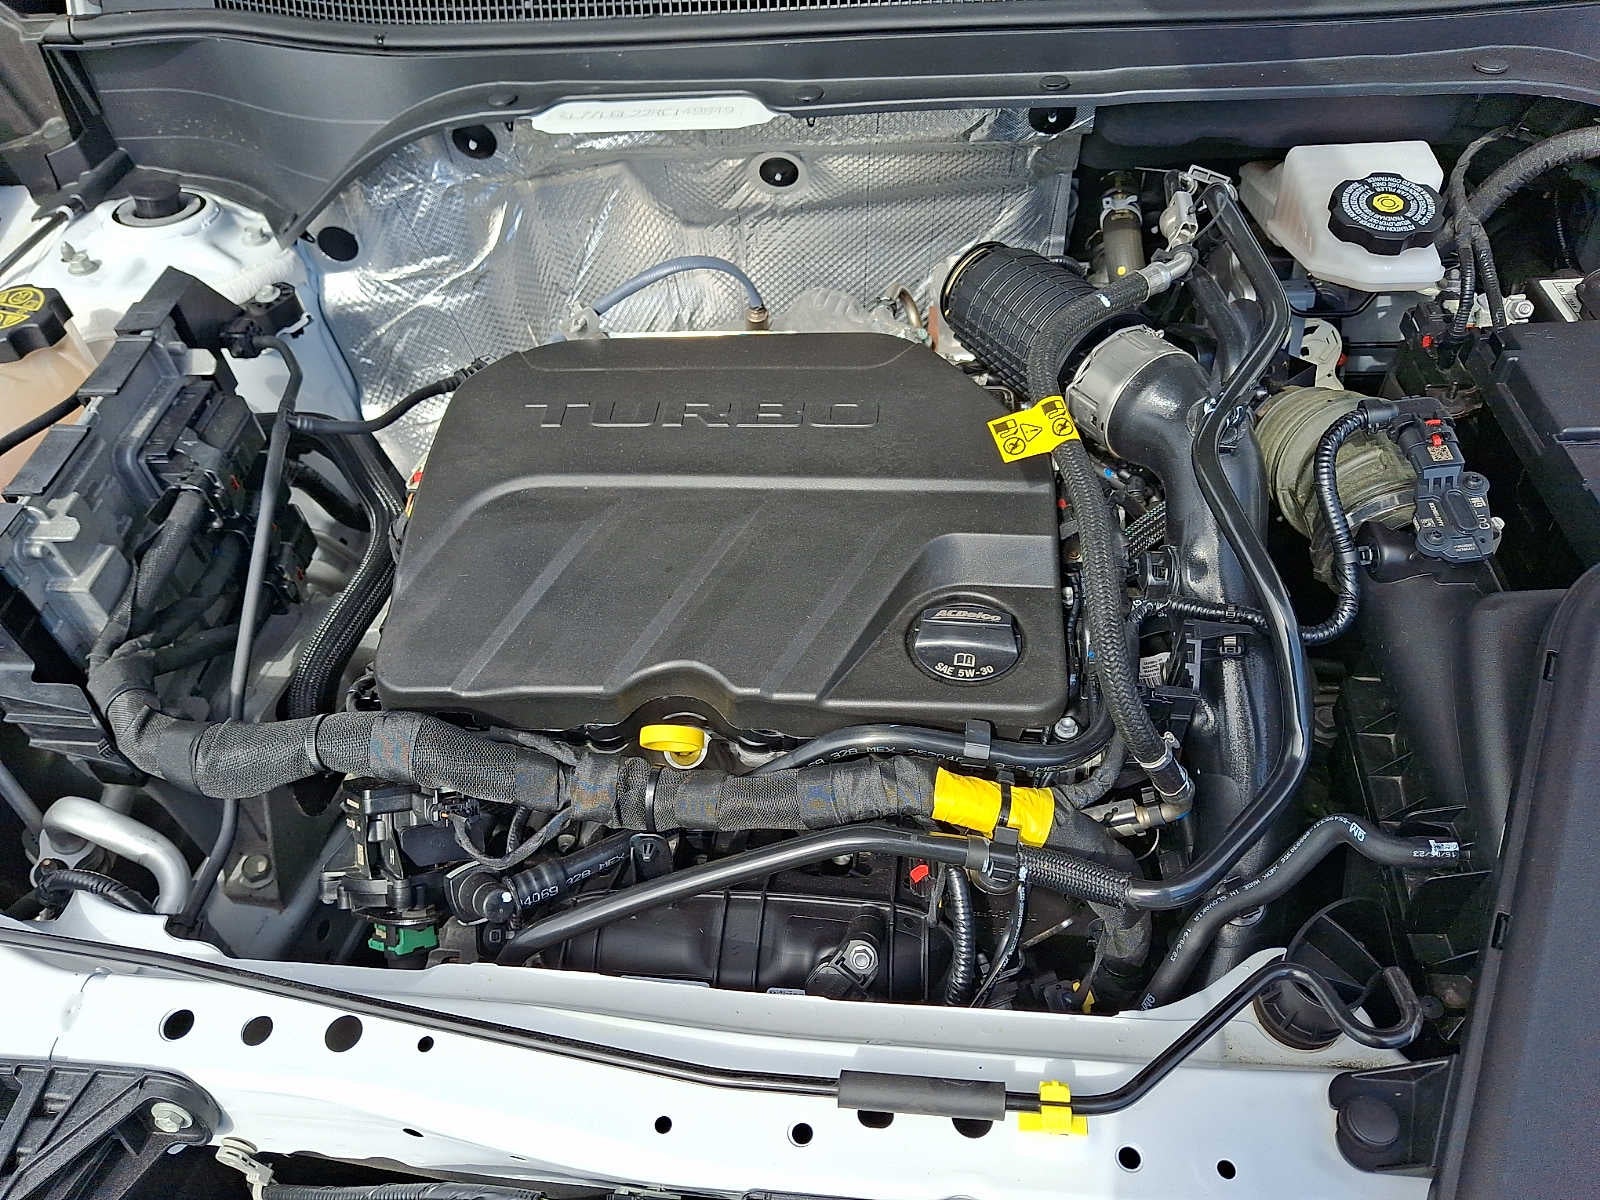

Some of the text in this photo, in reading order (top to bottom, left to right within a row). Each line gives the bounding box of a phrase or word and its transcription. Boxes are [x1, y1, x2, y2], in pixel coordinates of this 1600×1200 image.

[524, 400, 881, 428] TURBO
[934, 609, 1002, 623] ACDelco
[935, 662, 994, 678] SAE 5W-30
[1349, 822, 1367, 842] GM
[599, 852, 625, 871] MEX
[1229, 889, 1240, 897] IN
[1193, 896, 1229, 922] SLOVAKIA
